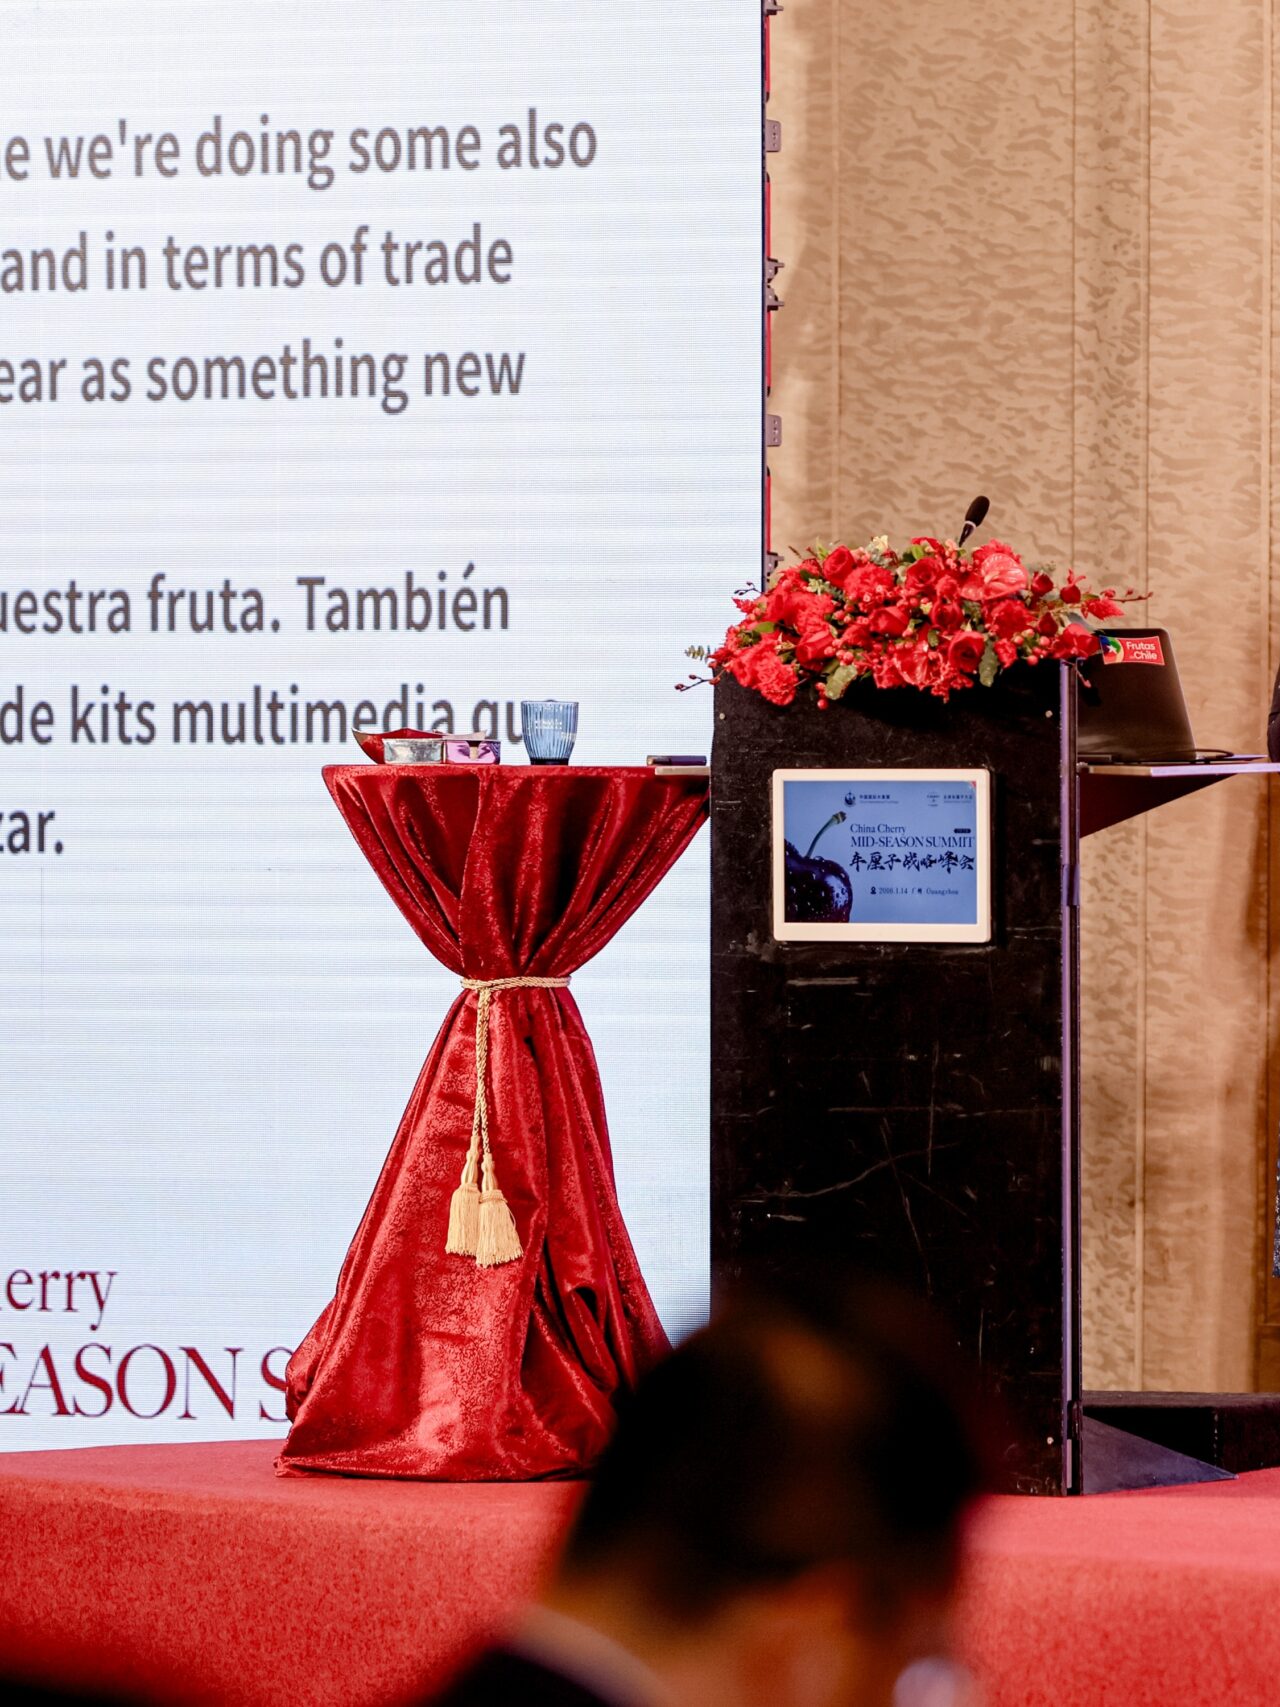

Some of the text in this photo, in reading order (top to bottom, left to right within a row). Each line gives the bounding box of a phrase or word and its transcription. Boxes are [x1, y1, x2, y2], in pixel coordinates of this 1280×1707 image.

[44, 119, 180, 179] we're
[196, 114, 335, 191] doing
[349, 125, 481, 173] some
[497, 107, 597, 170] also
[0, 222, 513, 294] and in terms of trade
[81, 358, 132, 403] as
[146, 338, 409, 415] something
[424, 352, 526, 397] new
[146, 572, 281, 634] fruta.
[296, 562, 510, 633] También
[1126, 641, 1156, 650] Frutas
[1133, 650, 1158, 660] Chile
[0, 682, 548, 746] de kits multimedia qu
[0, 810, 64, 855] ar.
[850, 824, 906, 835] China Cherry
[851, 836, 974, 848] MID-SEASON SUMMIT
[849, 850, 975, 873] 车厘子战略峰会
[0, 1269, 117, 1332] erry
